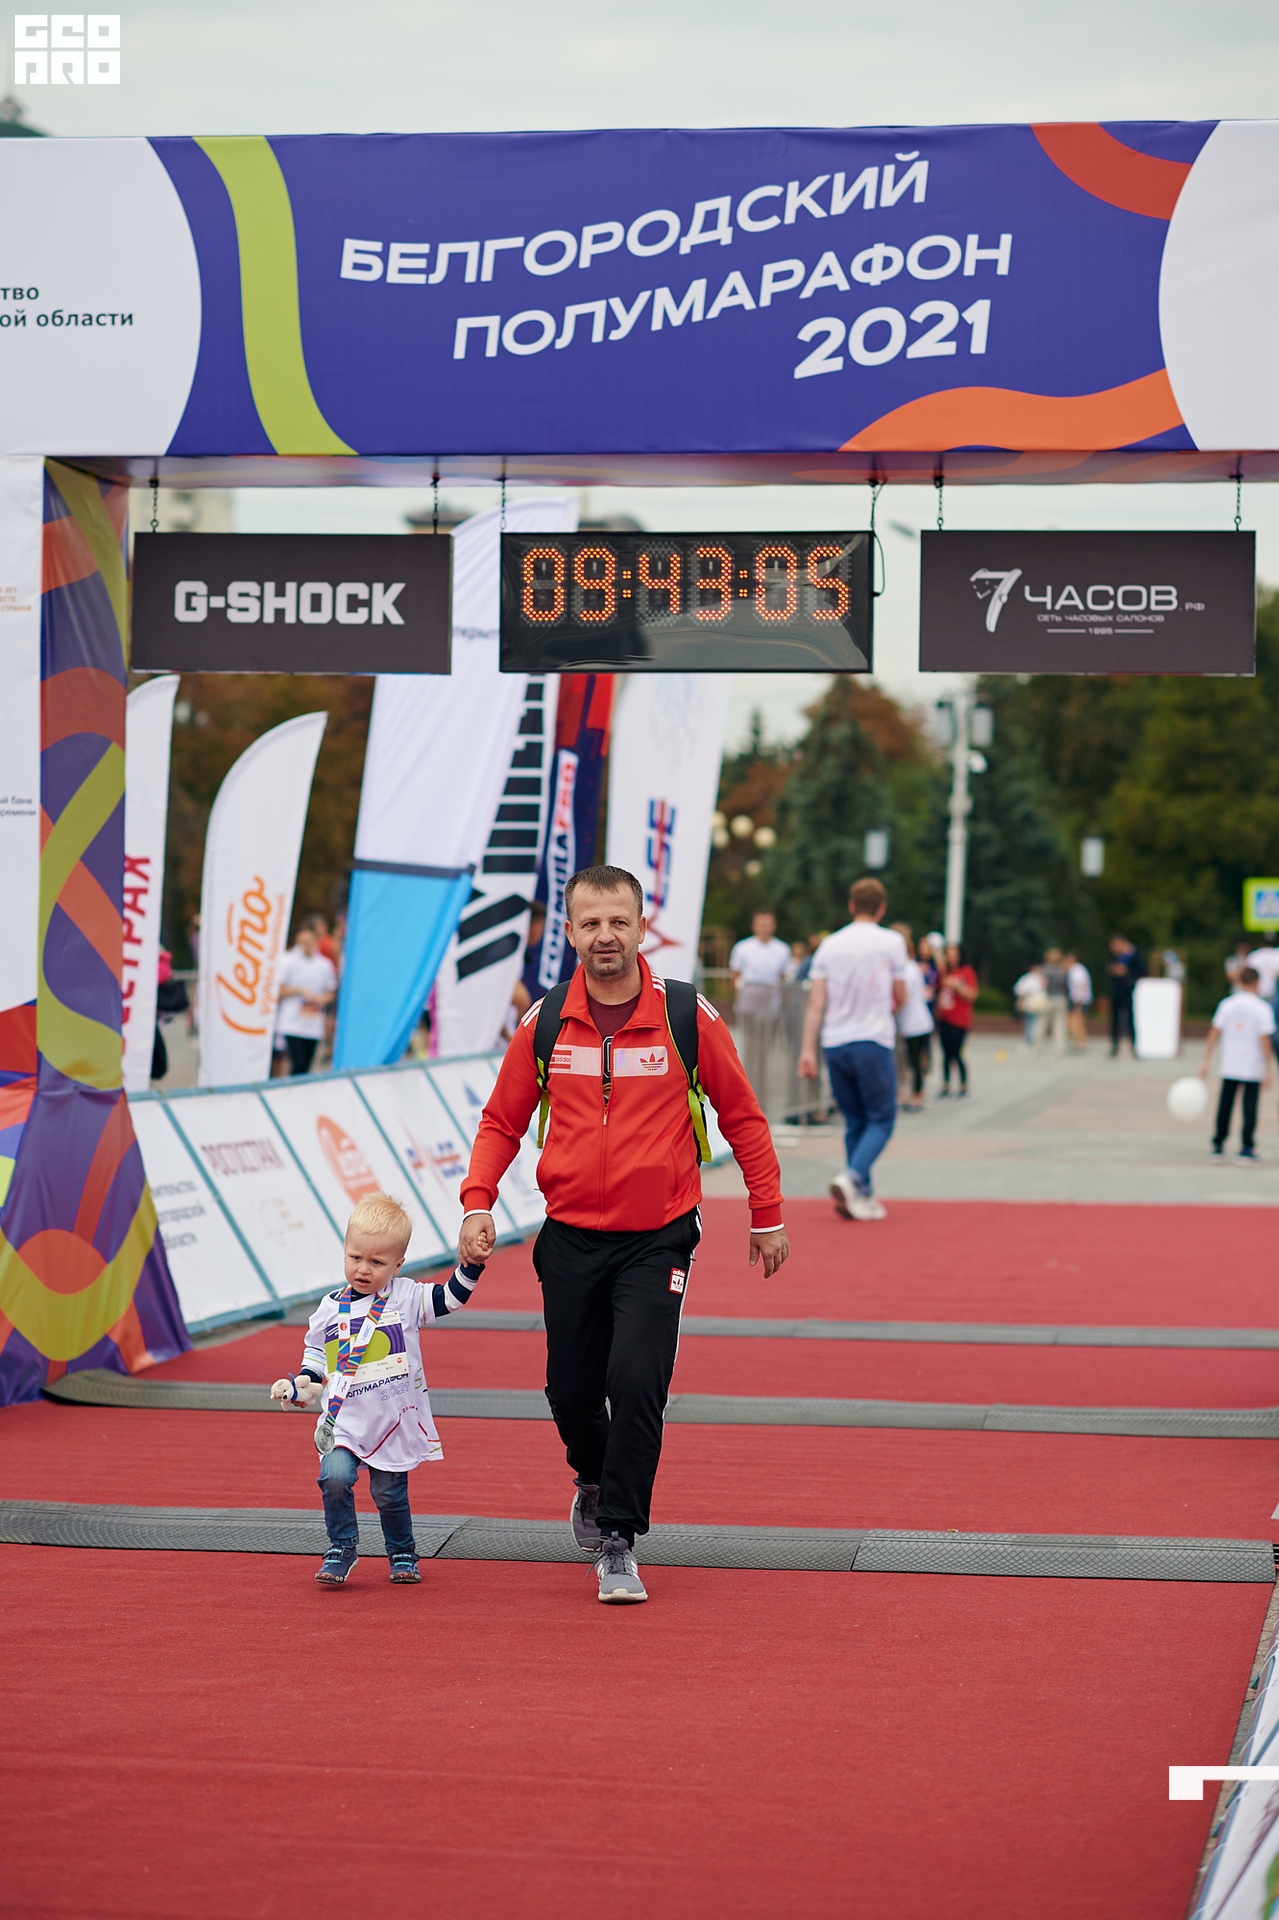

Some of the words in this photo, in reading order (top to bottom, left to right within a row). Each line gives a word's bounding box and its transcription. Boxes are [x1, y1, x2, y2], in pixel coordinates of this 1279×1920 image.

[340, 150, 929, 285] БЕЛГОРОДСКИЙ
[36, 309, 133, 327] области
[453, 233, 1012, 360] ПОЛУМАРАФОН
[794, 299, 991, 379] 2021
[174, 580, 406, 625] G-SHOCK
[522, 547, 850, 621] 09:43:05
[1024, 585, 1178, 611] ЧАСОВ
